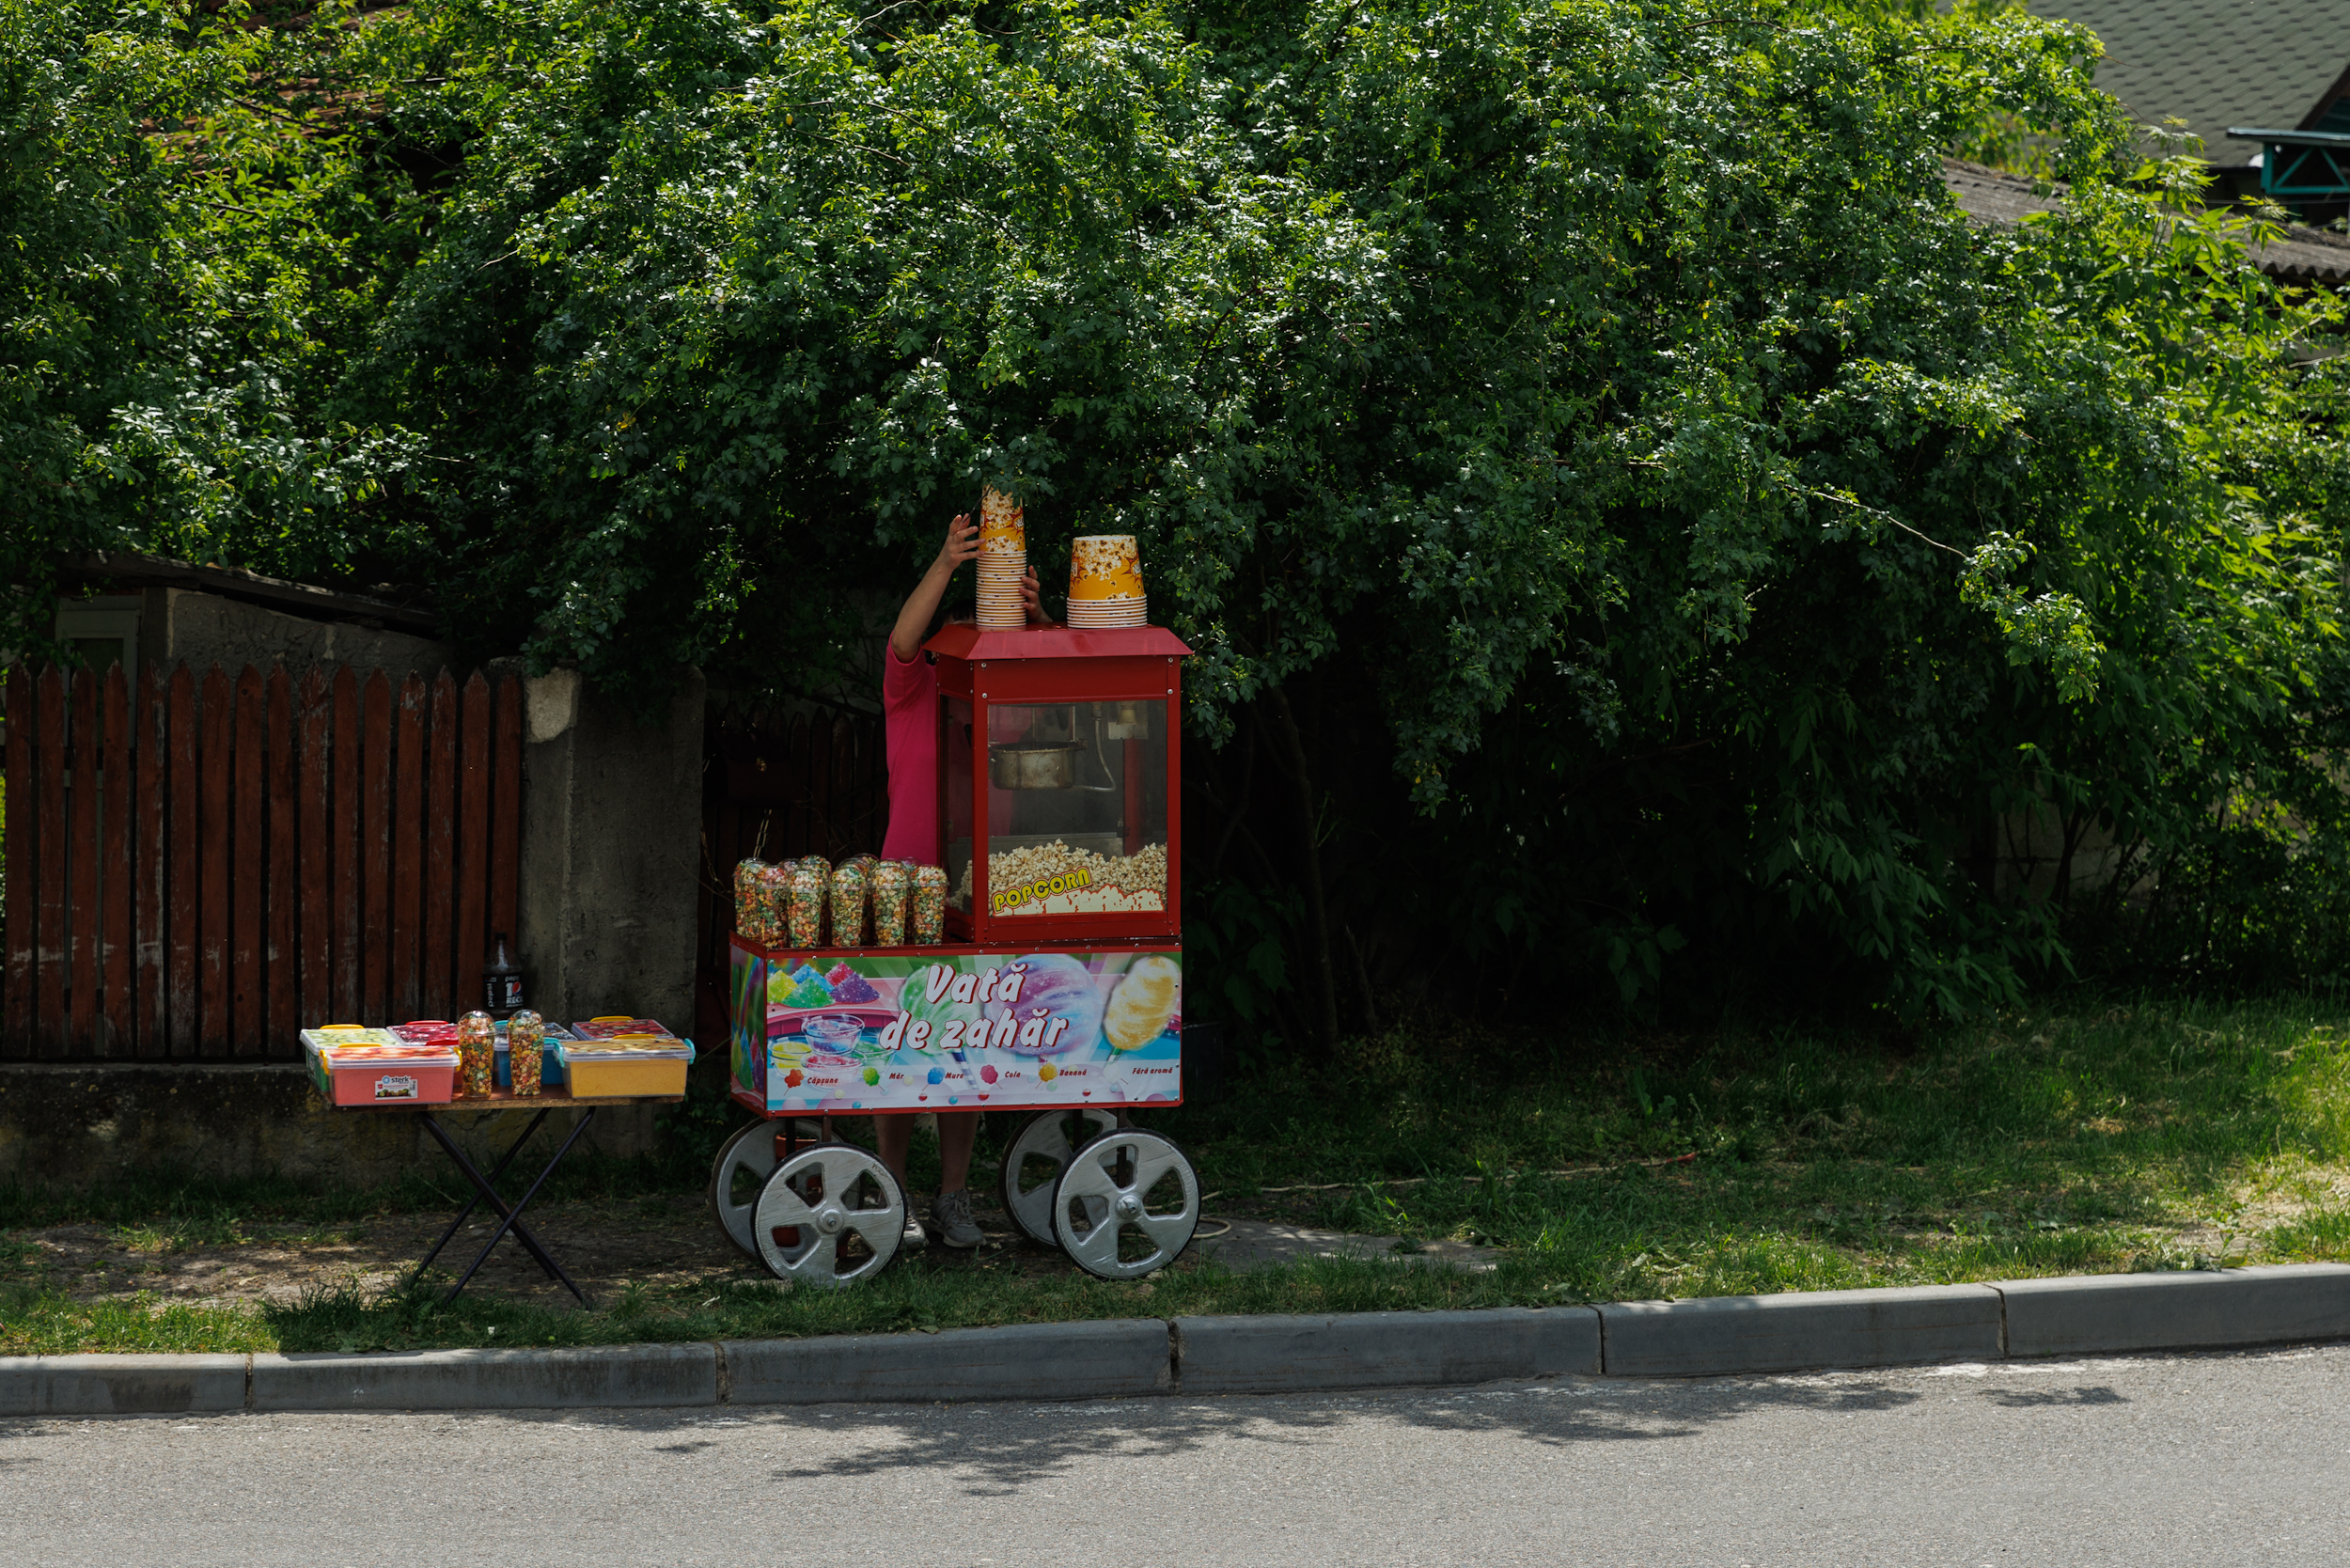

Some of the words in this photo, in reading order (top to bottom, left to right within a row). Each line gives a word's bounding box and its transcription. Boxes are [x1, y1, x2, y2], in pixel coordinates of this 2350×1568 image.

[993, 867, 1092, 913] POPCORN
[925, 963, 1028, 1004] Vată
[879, 1009, 932, 1050] de
[939, 1007, 1070, 1049] zahăr
[888, 1072, 904, 1080] Măr
[1150, 1066, 1173, 1074] aromă
